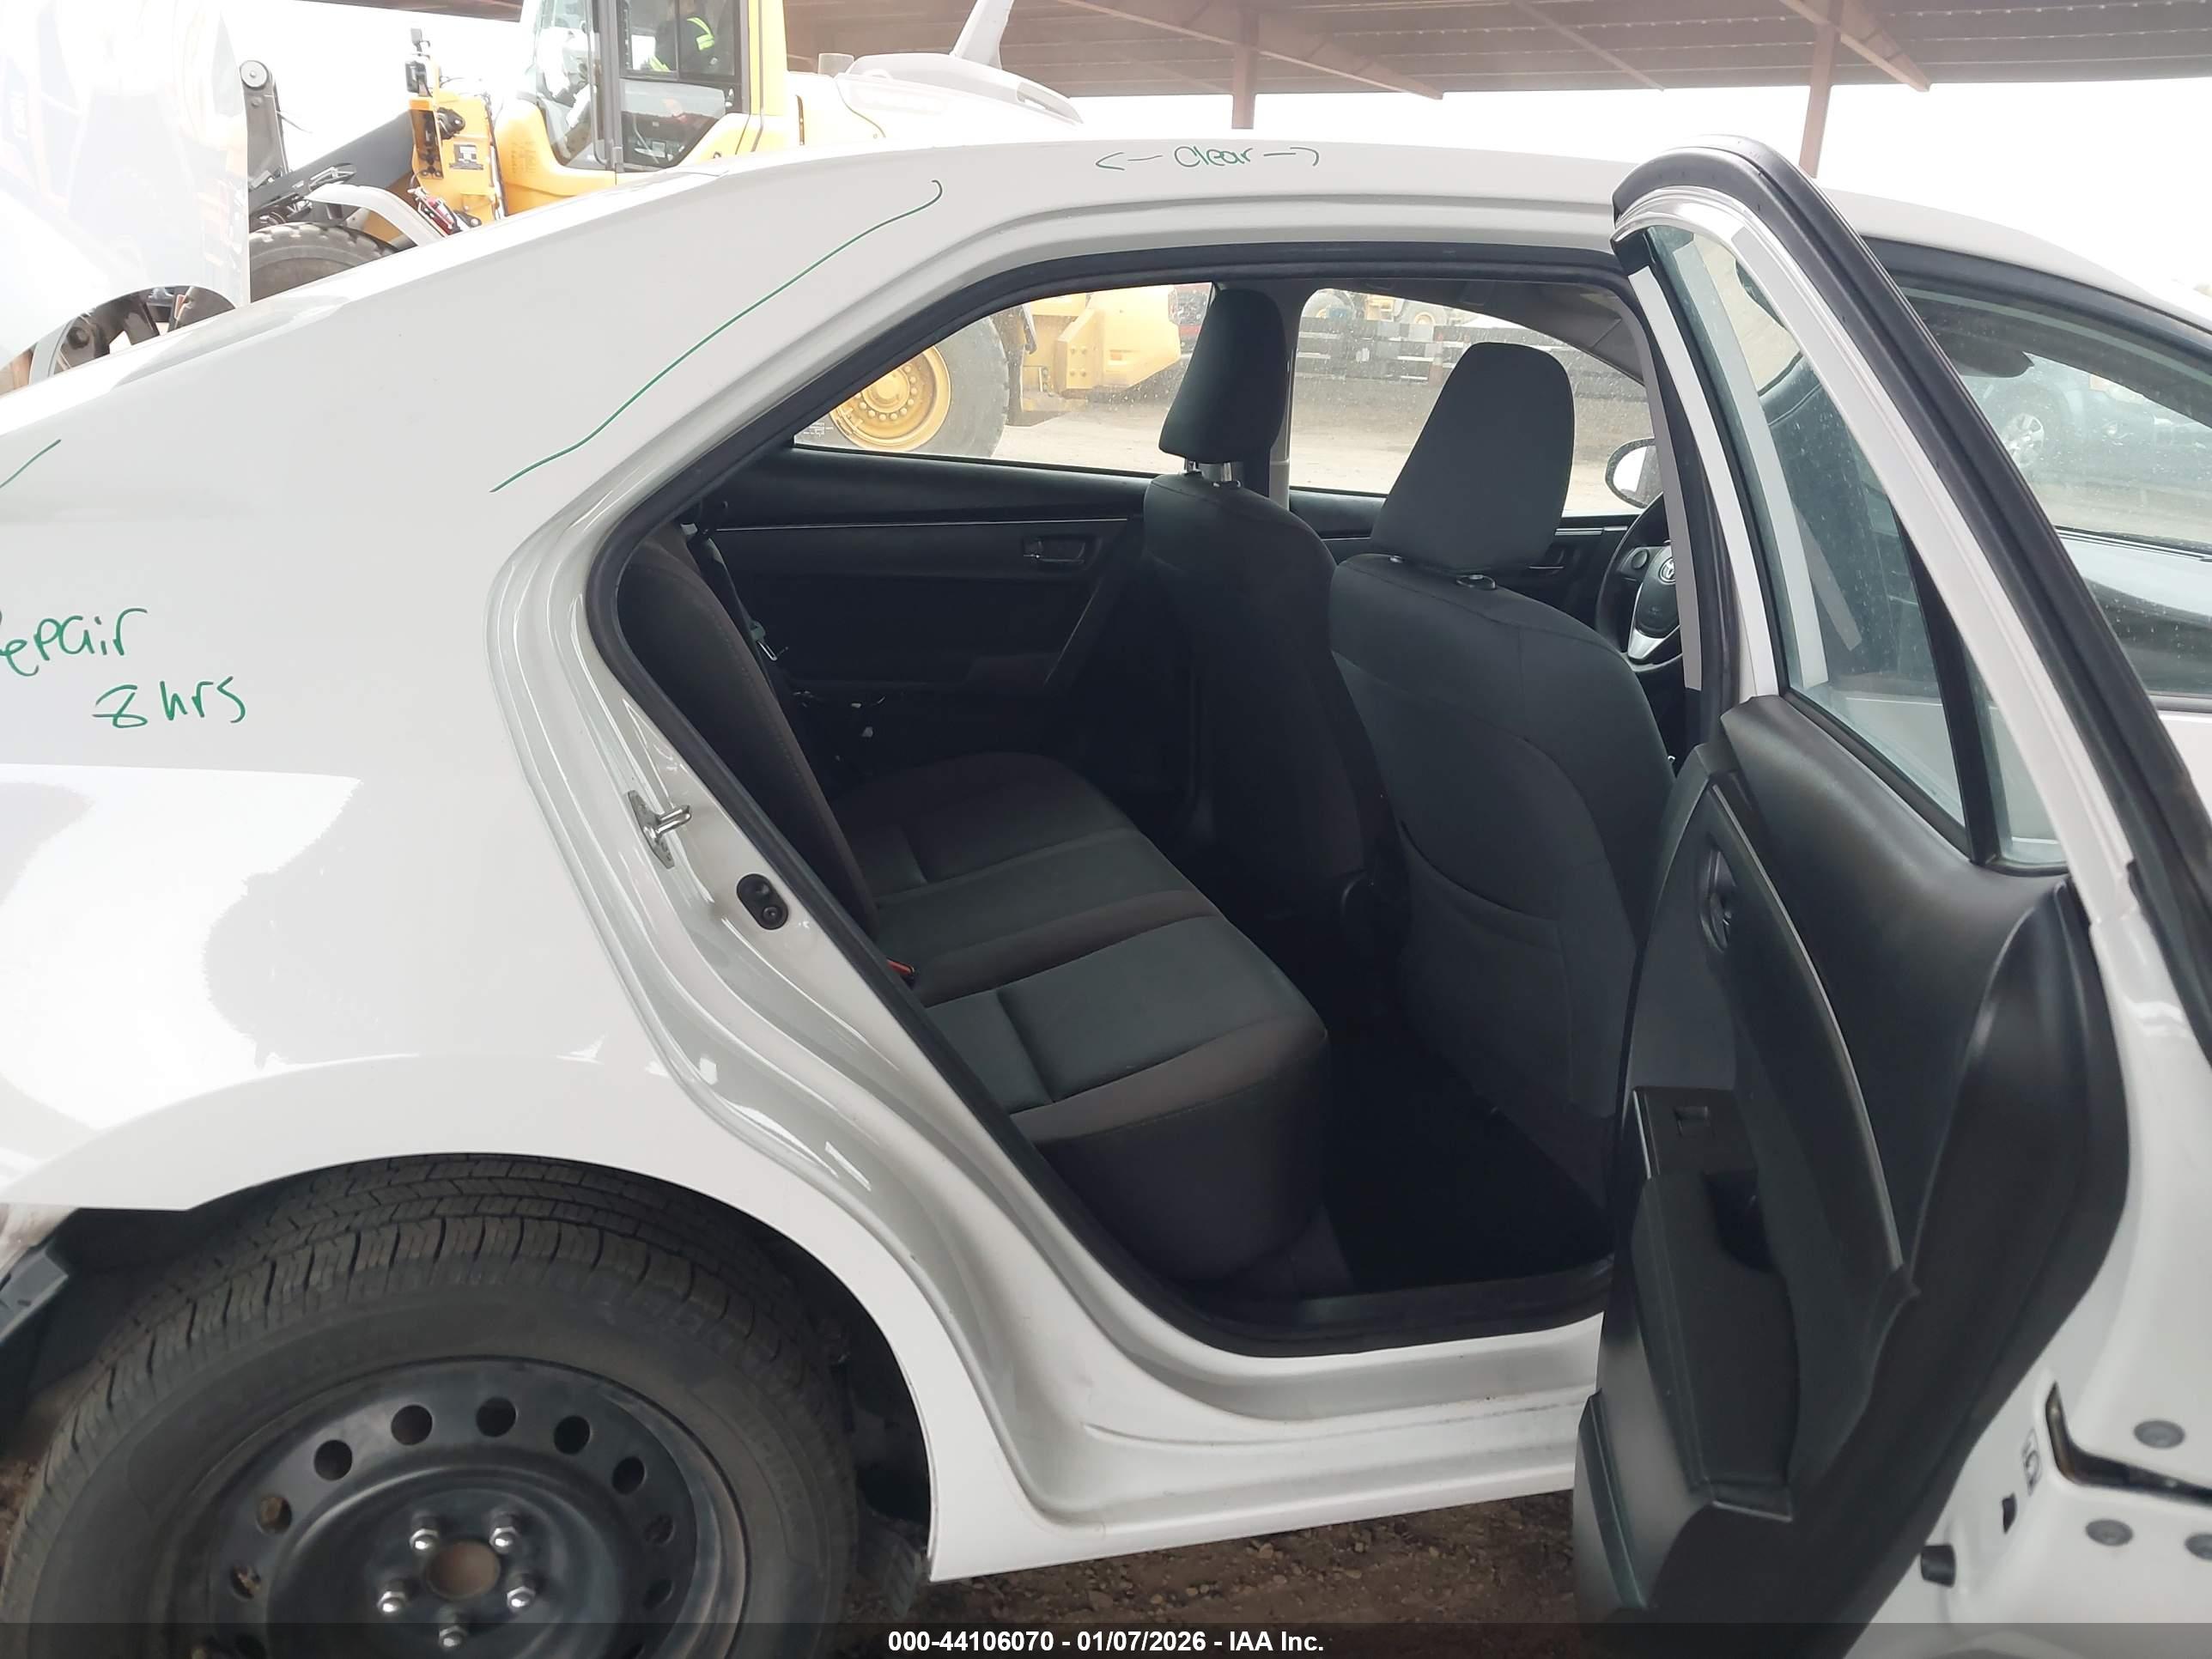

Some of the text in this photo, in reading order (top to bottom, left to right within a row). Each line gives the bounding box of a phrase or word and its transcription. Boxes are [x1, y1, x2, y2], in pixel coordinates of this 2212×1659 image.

[1174, 145, 1254, 167] Clear
[0, 607, 148, 677] epair
[91, 676, 246, 728] 8 hrs
